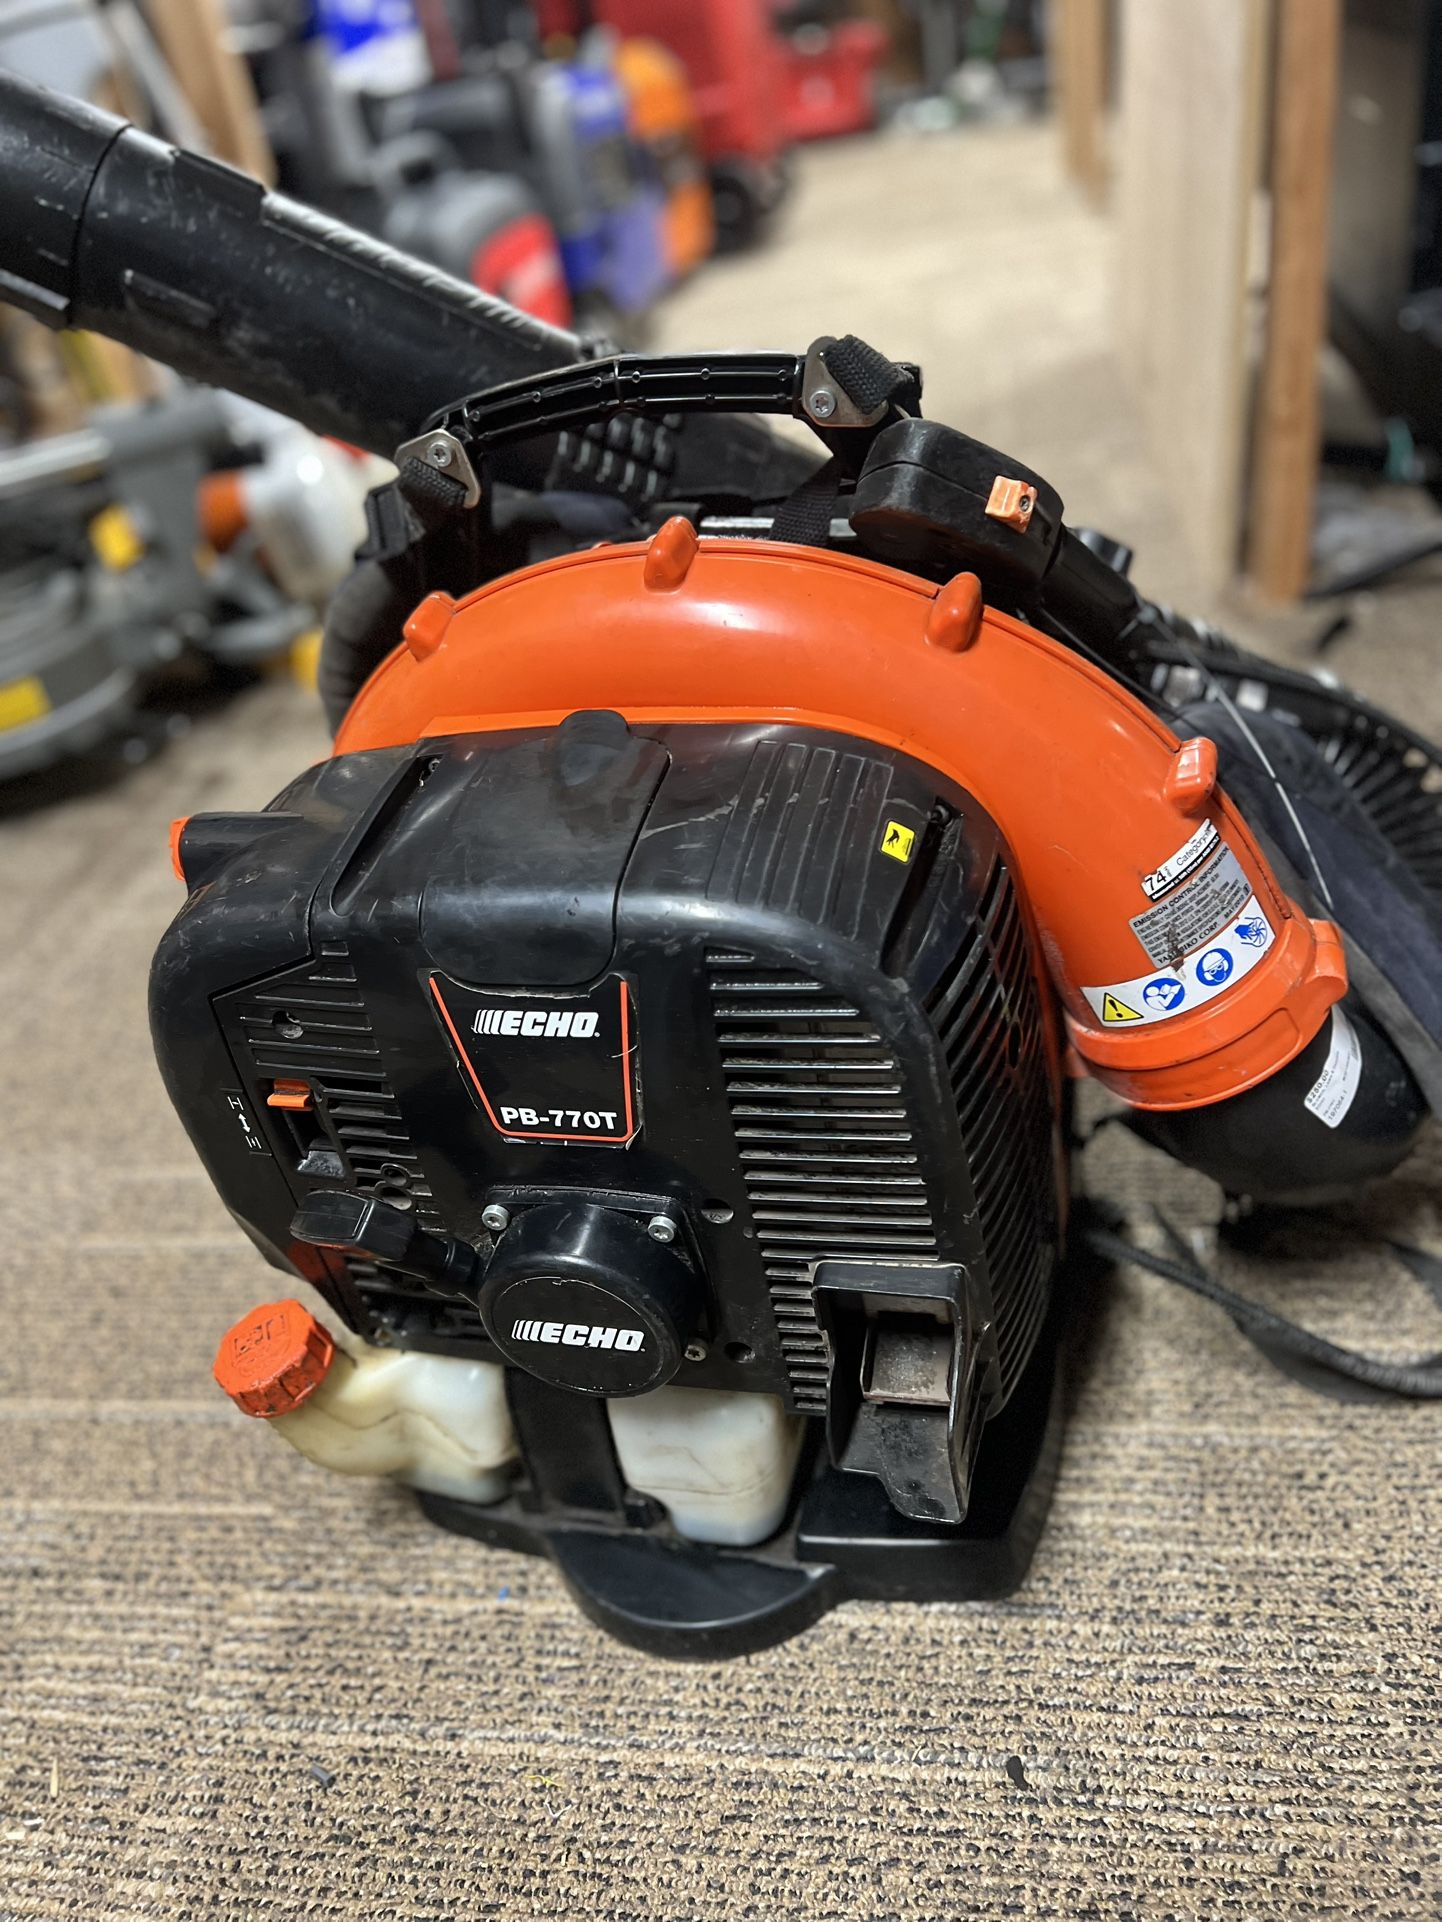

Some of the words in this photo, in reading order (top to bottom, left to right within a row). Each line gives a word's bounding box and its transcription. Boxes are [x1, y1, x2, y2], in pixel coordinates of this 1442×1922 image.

[1133, 905, 1168, 928] EMISSION
[1168, 882, 1200, 907] CONTROL
[1198, 846, 1229, 882] INFORMATION
[499, 1010, 600, 1038] ECHO
[500, 1106, 617, 1130] PB-770T
[540, 1321, 645, 1352] ECHO
